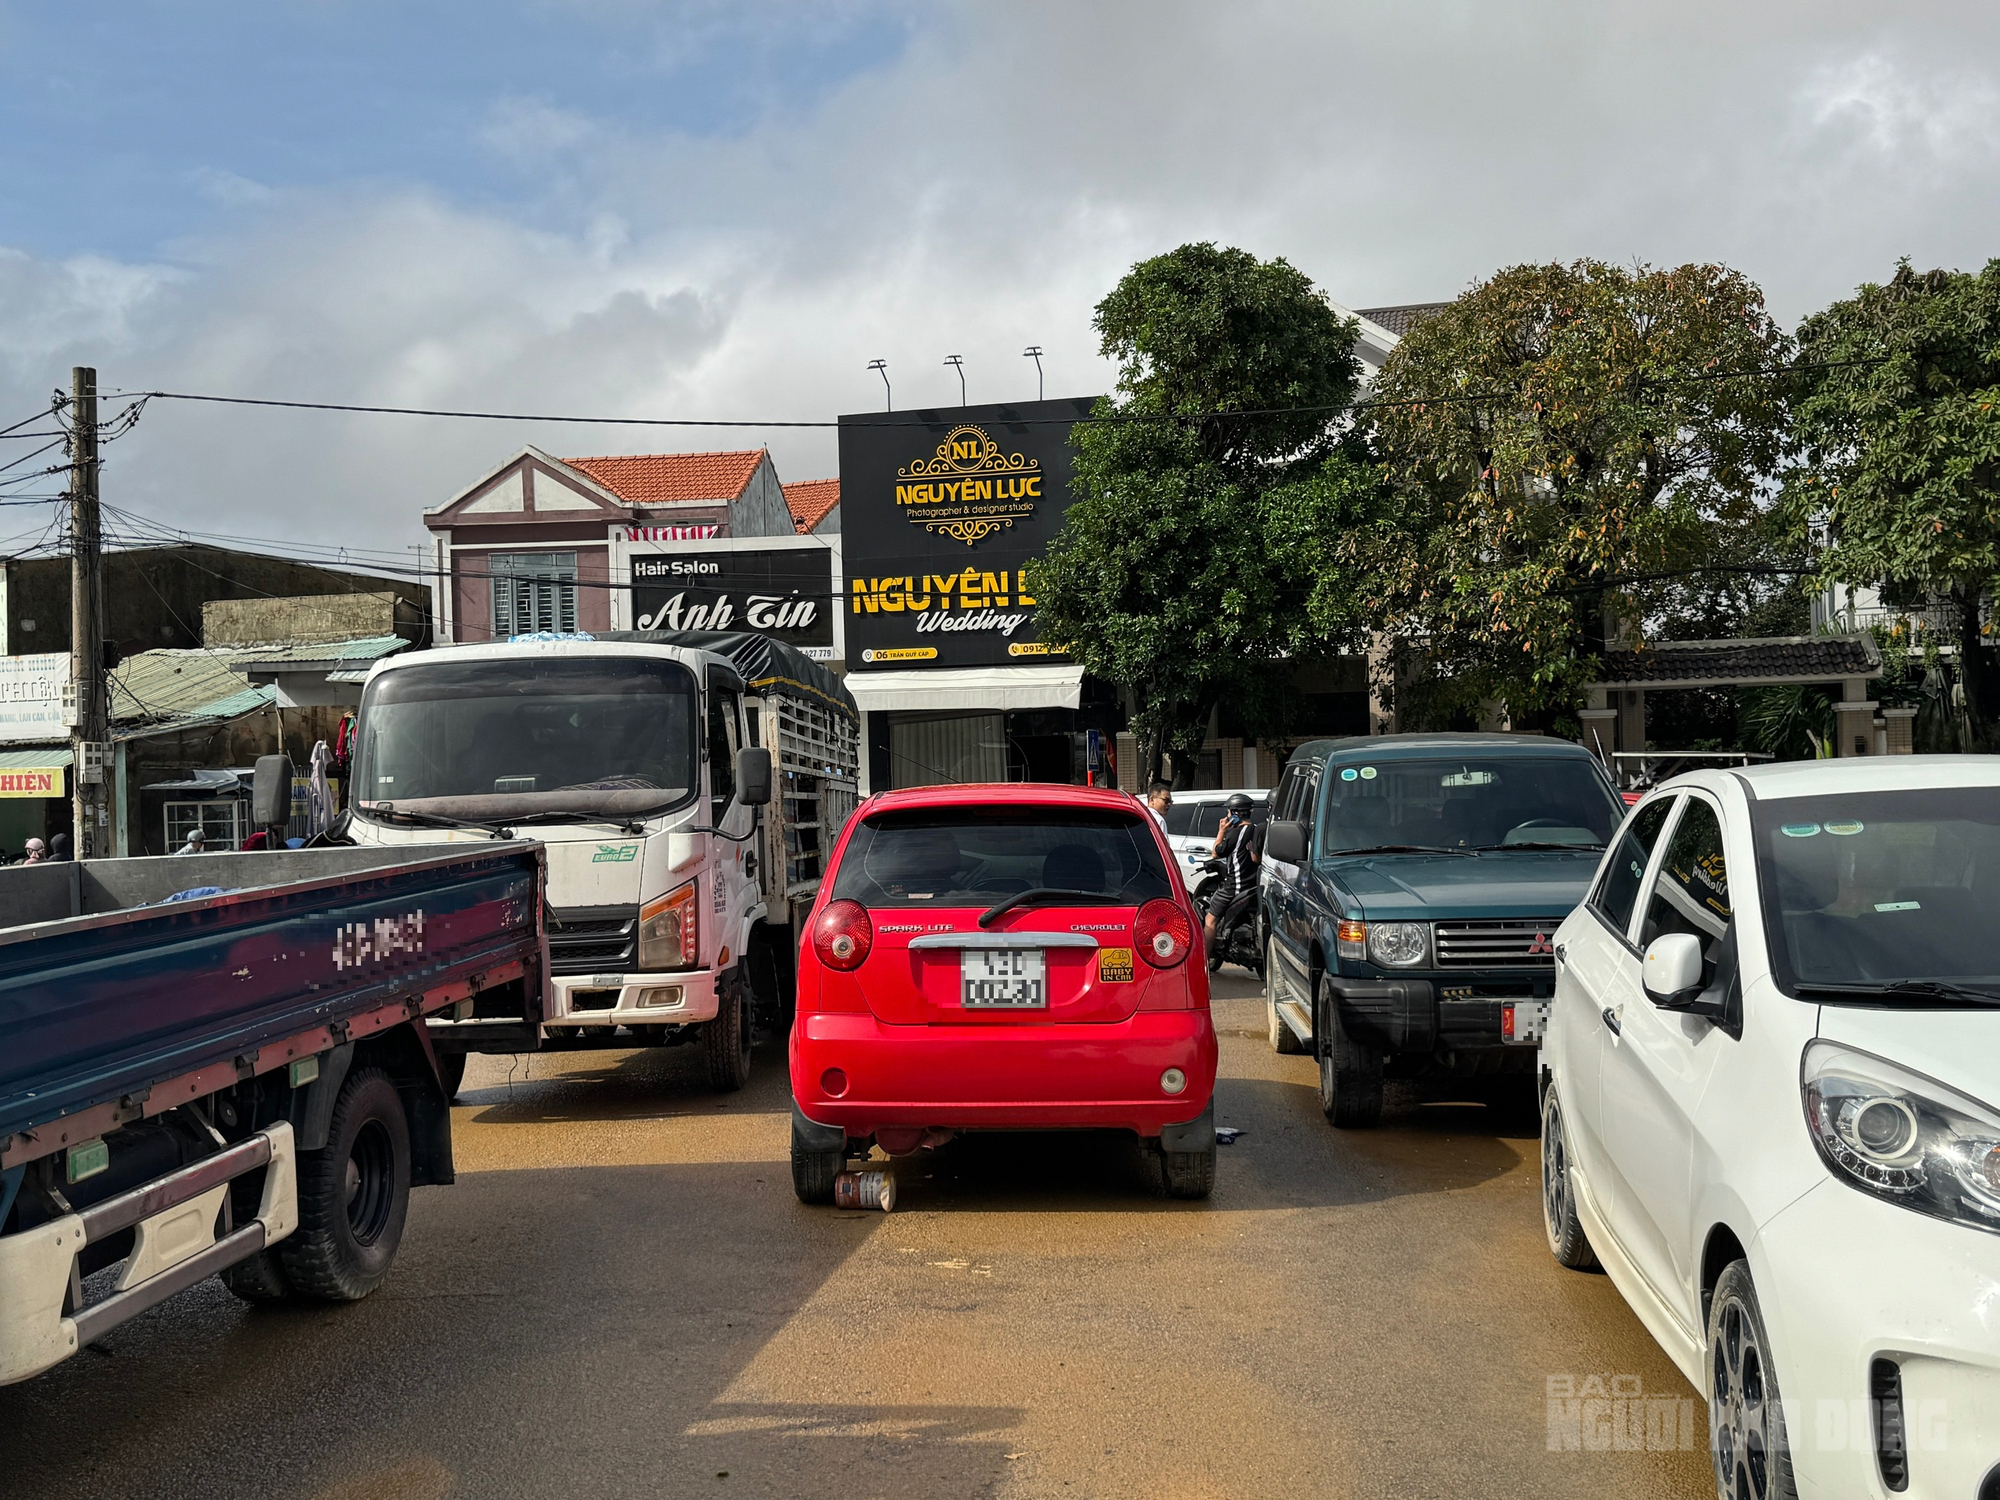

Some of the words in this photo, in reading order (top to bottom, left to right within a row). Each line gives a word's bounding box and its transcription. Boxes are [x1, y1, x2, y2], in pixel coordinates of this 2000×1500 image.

[952, 441, 982, 460] NL
[896, 478, 992, 504] NGUYÊN
[996, 477, 1042, 501] LỰC
[907, 506, 962, 518] Photographer
[963, 505, 970, 515] &
[972, 503, 1008, 516] designer
[1009, 502, 1034, 512] studio
[635, 561, 669, 576] Hair
[671, 560, 719, 575] Salon
[852, 566, 1009, 614] NGUYÊN
[637, 591, 735, 631] Anh
[916, 608, 1028, 637] Wedding
[820, 649, 831, 658] 779
[875, 651, 888, 660] 06
[879, 924, 924, 933] SPARK
[928, 923, 955, 932] LITE
[1070, 924, 1126, 932] CHEVROLET
